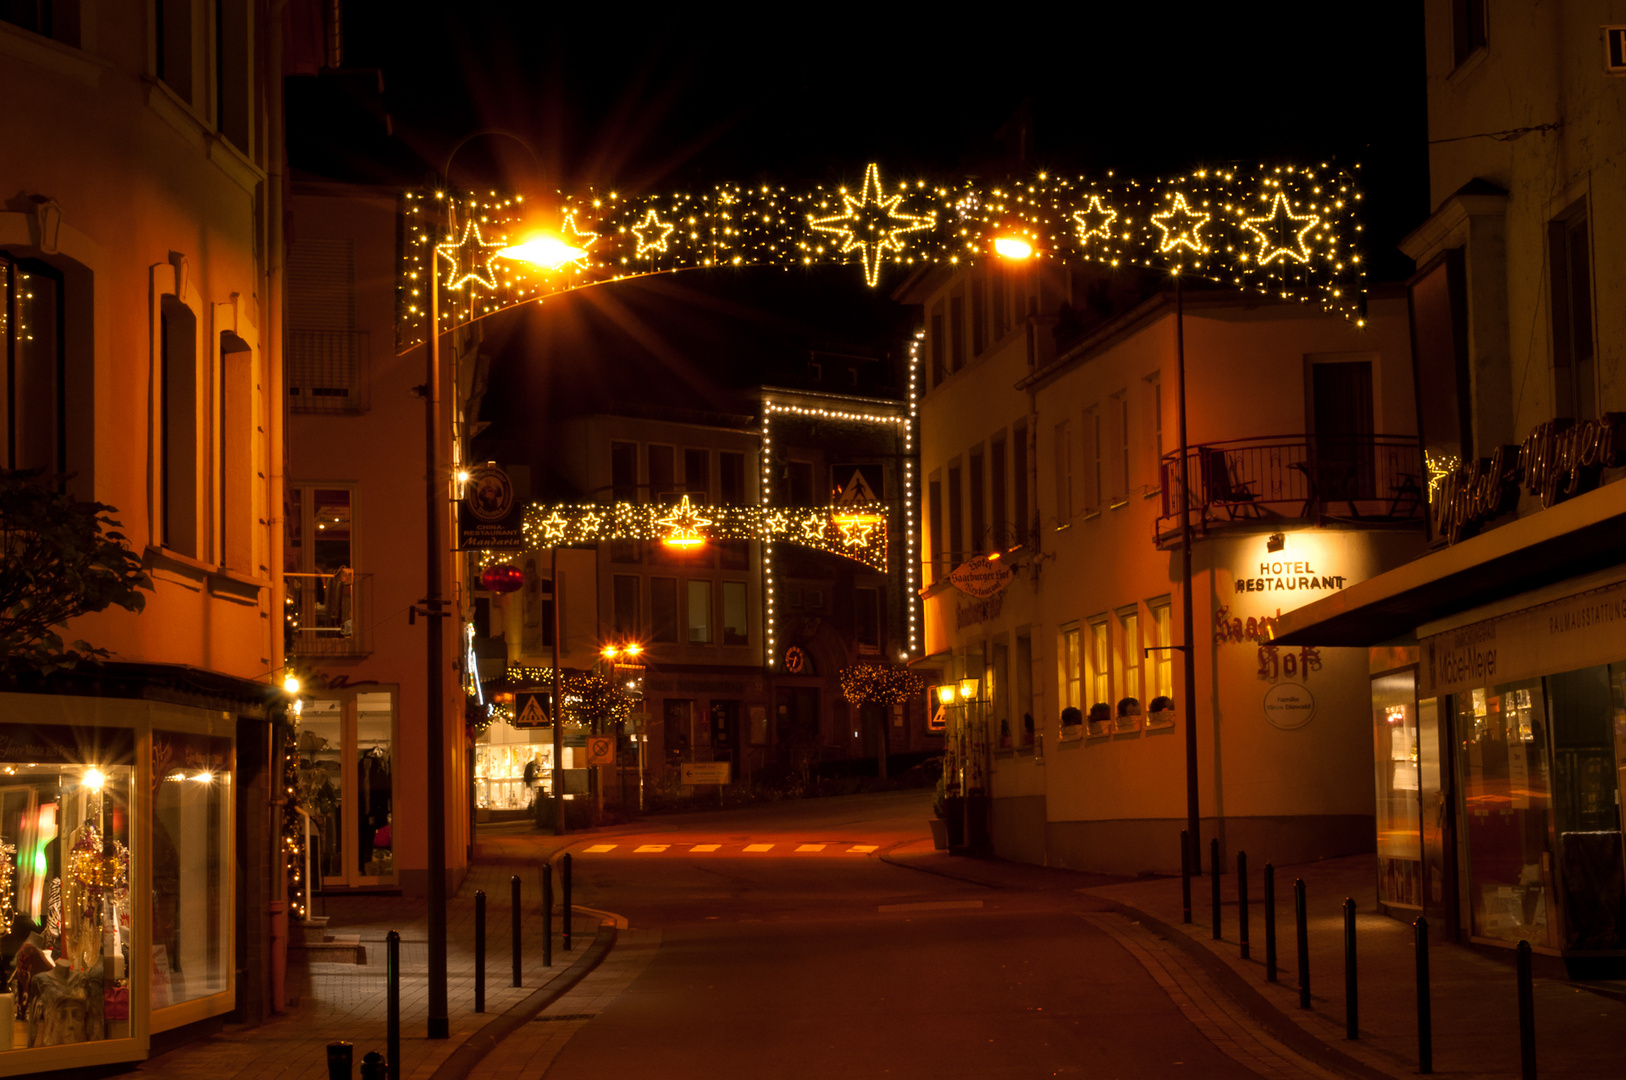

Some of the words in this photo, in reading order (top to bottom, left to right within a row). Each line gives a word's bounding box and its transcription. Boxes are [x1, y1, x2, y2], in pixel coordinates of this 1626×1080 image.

[462, 537, 519, 547] Mandarin
[968, 558, 993, 571] Hotel
[1260, 561, 1315, 575] HOTEL
[995, 569, 1010, 581] Hof
[965, 581, 1002, 596] Restaurant
[1236, 576, 1346, 593] RESTAURANT
